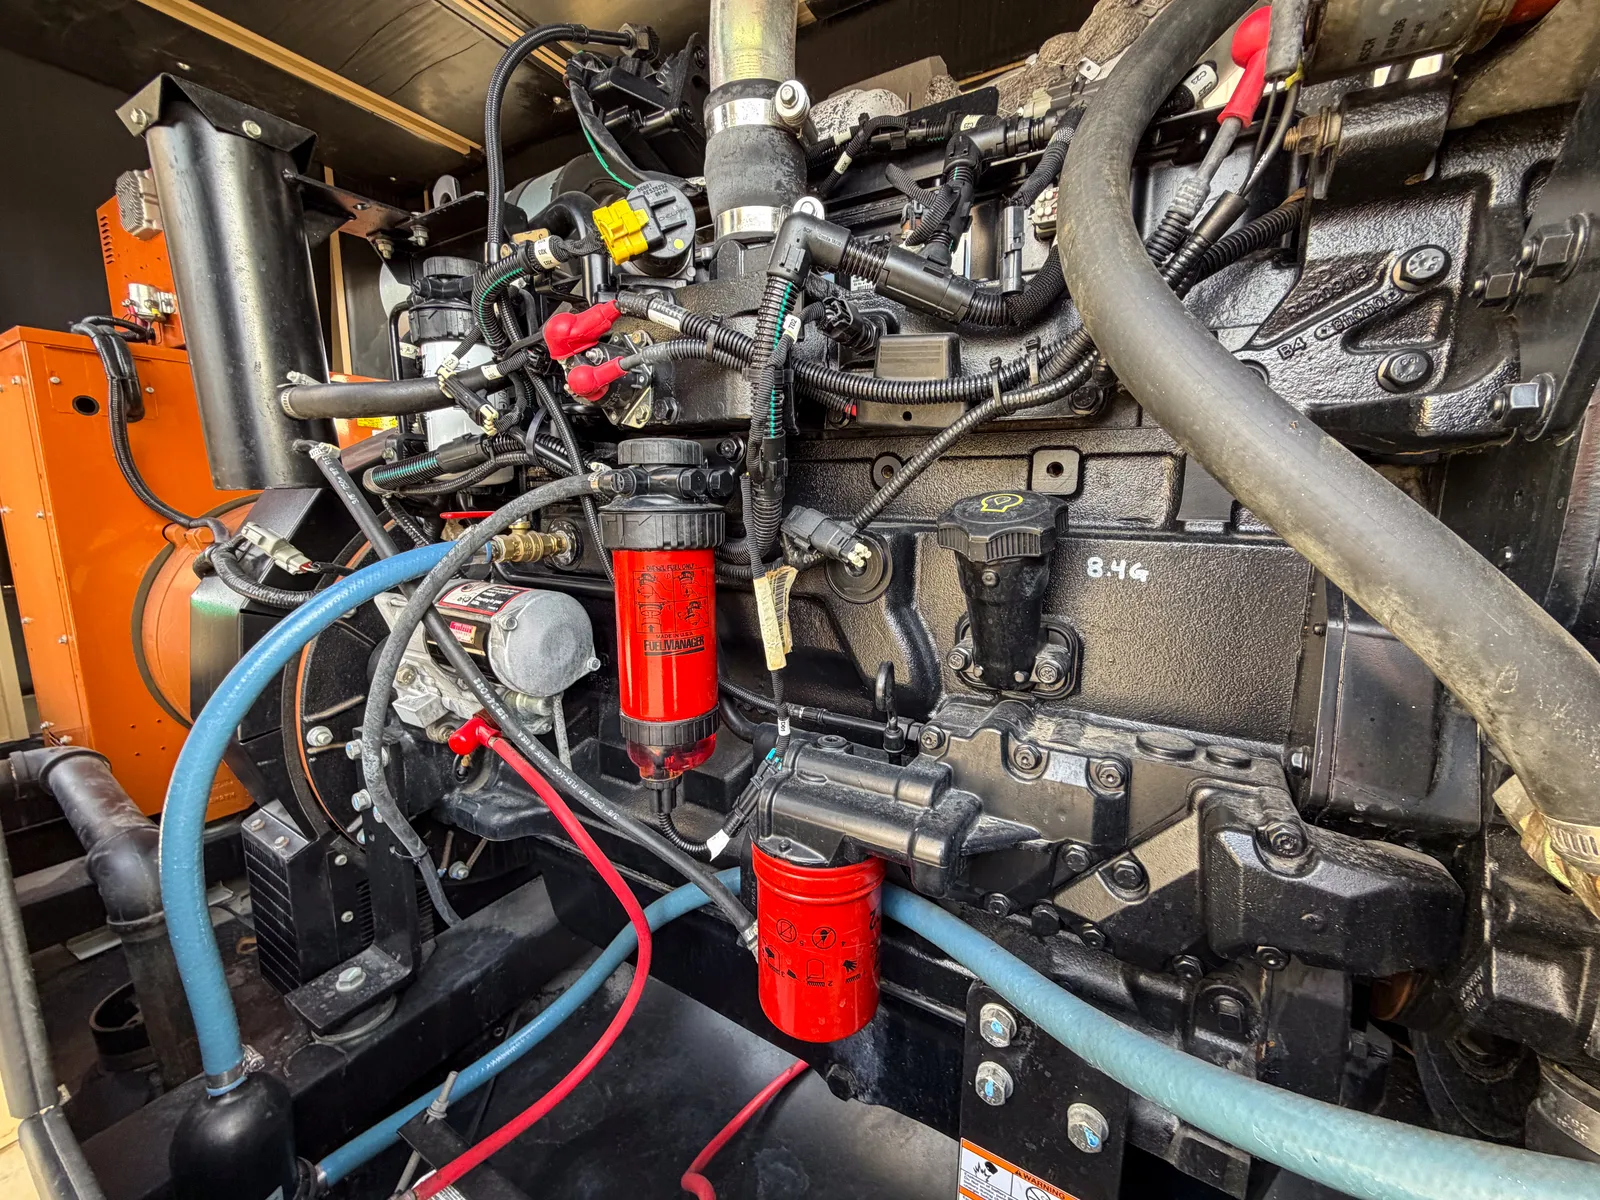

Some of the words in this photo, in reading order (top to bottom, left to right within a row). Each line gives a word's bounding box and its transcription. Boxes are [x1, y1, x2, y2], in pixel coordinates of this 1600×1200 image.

[1278, 336, 1307, 360] B4
[535, 750, 551, 764] MADE
[552, 766, 578, 790] FLEX-LOC
[1023, 1174, 1066, 1200] WARNING
